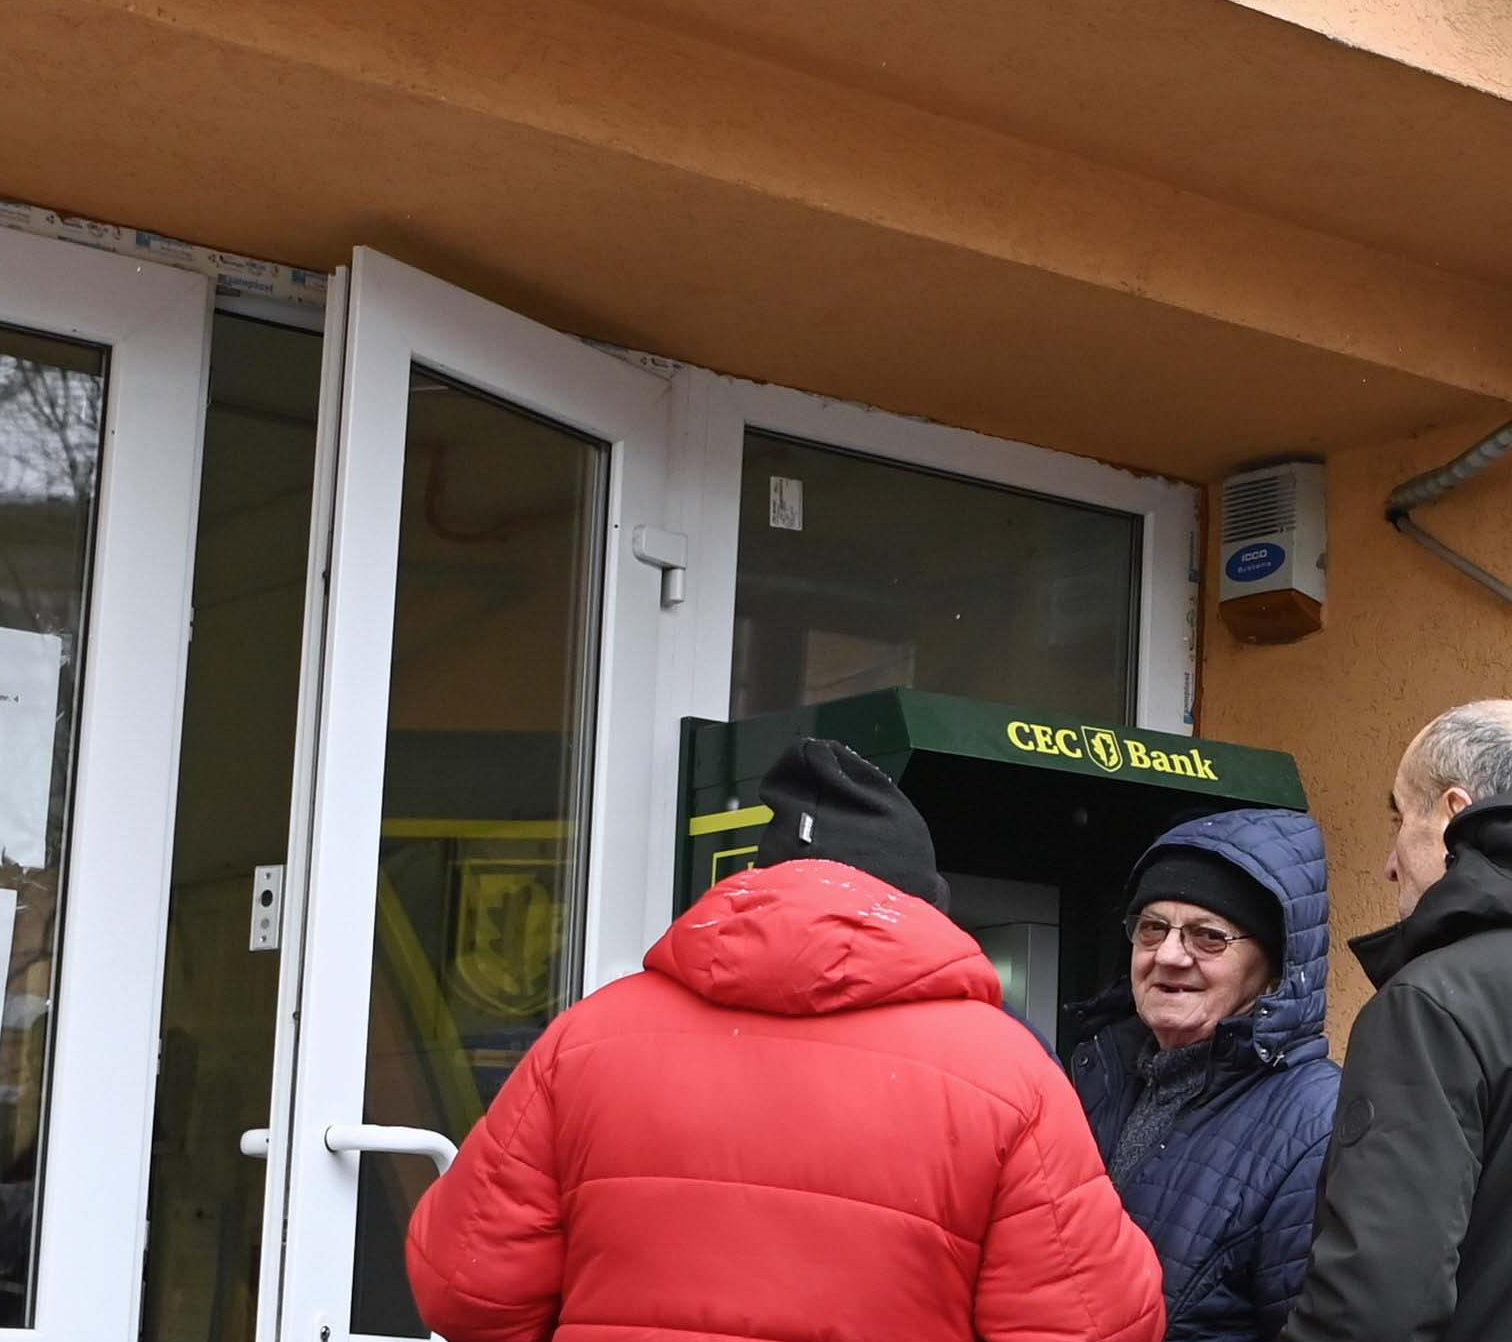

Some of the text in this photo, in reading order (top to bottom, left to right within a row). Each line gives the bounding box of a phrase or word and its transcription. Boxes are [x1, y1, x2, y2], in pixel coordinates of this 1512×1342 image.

[1241, 549, 1268, 562] ICCO
[1007, 721, 1218, 780] CEC Bank
